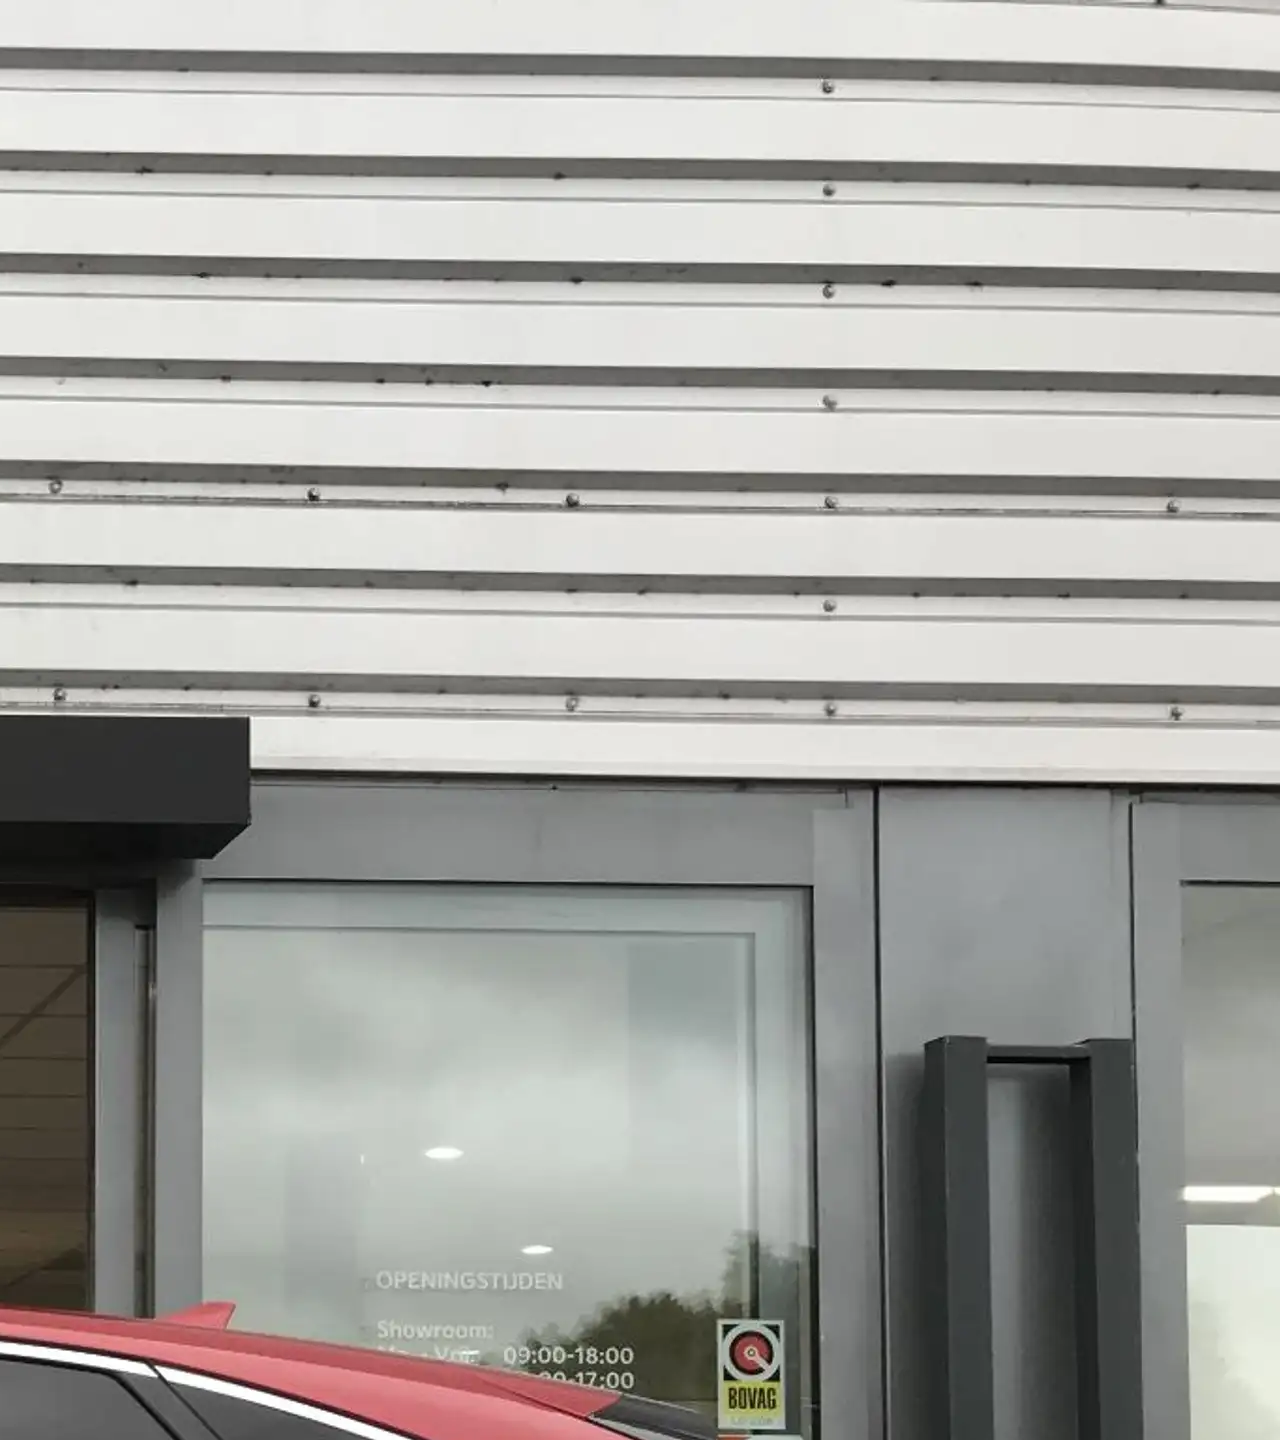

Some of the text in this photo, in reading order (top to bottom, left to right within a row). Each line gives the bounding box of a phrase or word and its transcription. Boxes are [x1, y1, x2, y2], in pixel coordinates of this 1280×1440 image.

[376, 1271, 563, 1290] OPENINGSTIJDEN
[377, 1320, 493, 1339] Showroom:
[503, 1347, 634, 1364] 09:00-18:00
[728, 1387, 777, 1409] BOVAG
